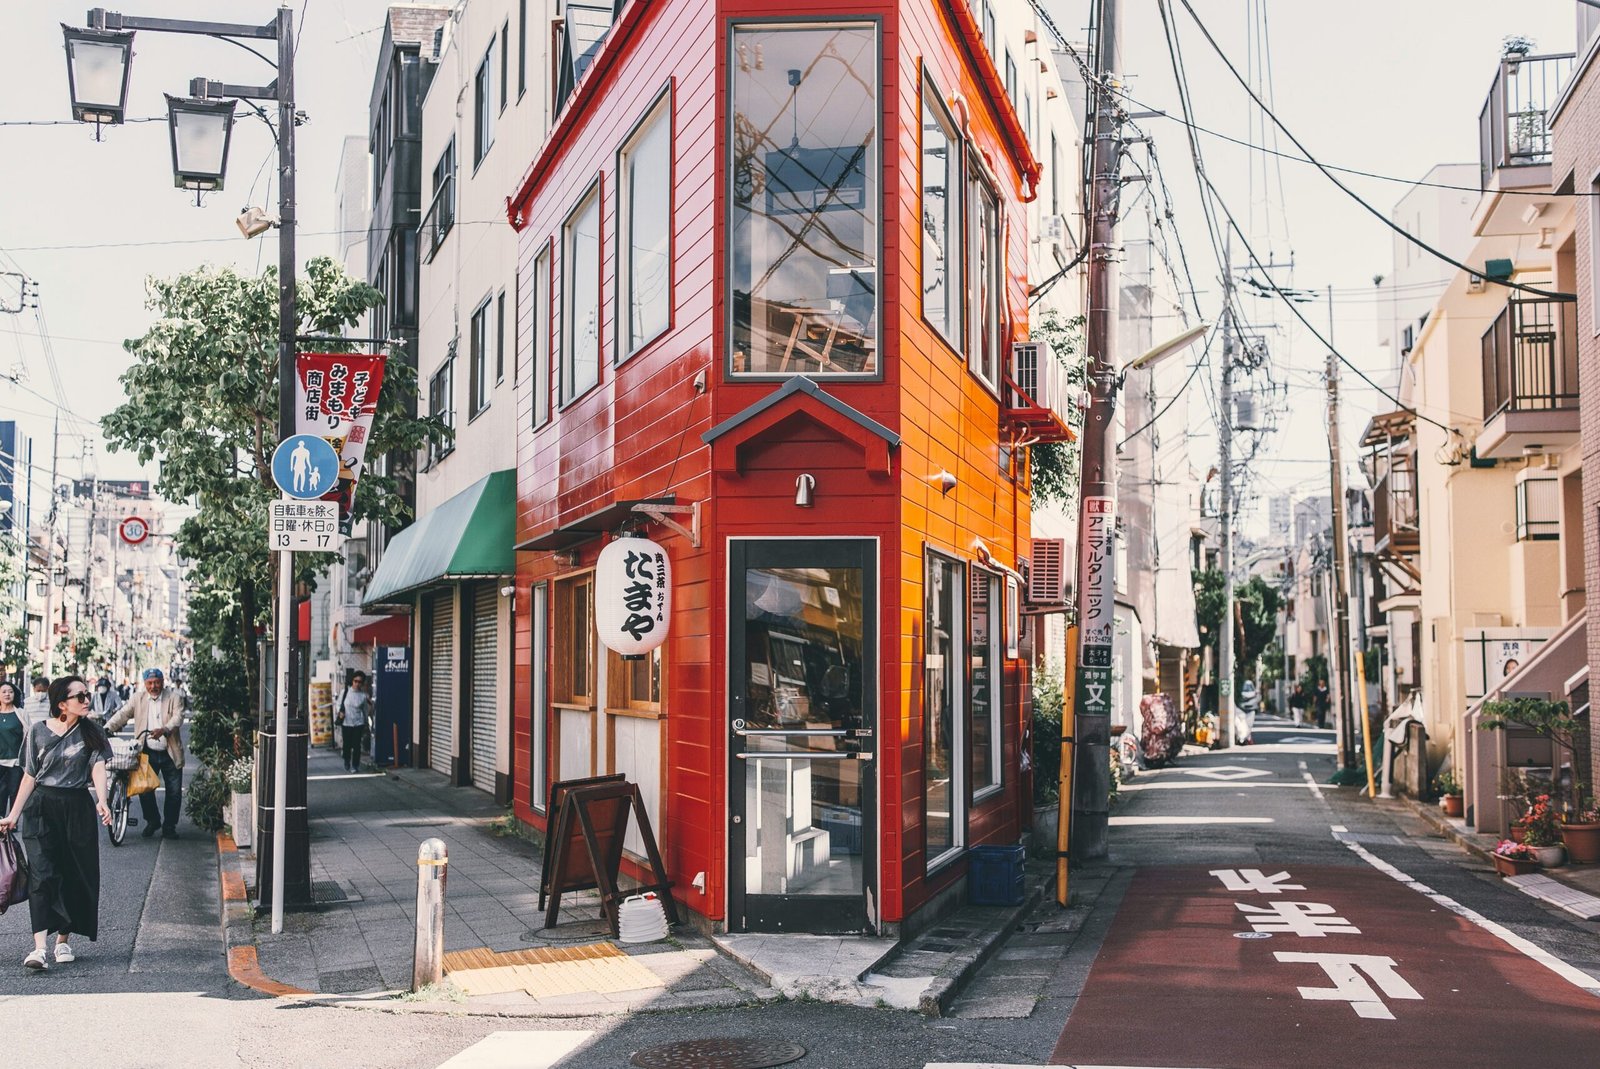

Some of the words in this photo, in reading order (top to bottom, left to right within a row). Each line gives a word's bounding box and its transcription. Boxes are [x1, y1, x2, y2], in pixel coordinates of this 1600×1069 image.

[305, 370, 323, 421] 商店街
[327, 363, 348, 430] みまもり
[349, 371, 370, 420] 子ども
[273, 504, 335, 517] 自転車を除く
[126, 525, 143, 537] 30
[277, 534, 291, 547] 13
[316, 534, 331, 547] 17
[621, 550, 655, 641] たまや
[385, 660, 409, 669] Asahi
[1084, 681, 1106, 706] 文
[1209, 868, 1425, 1020] 止まれ
